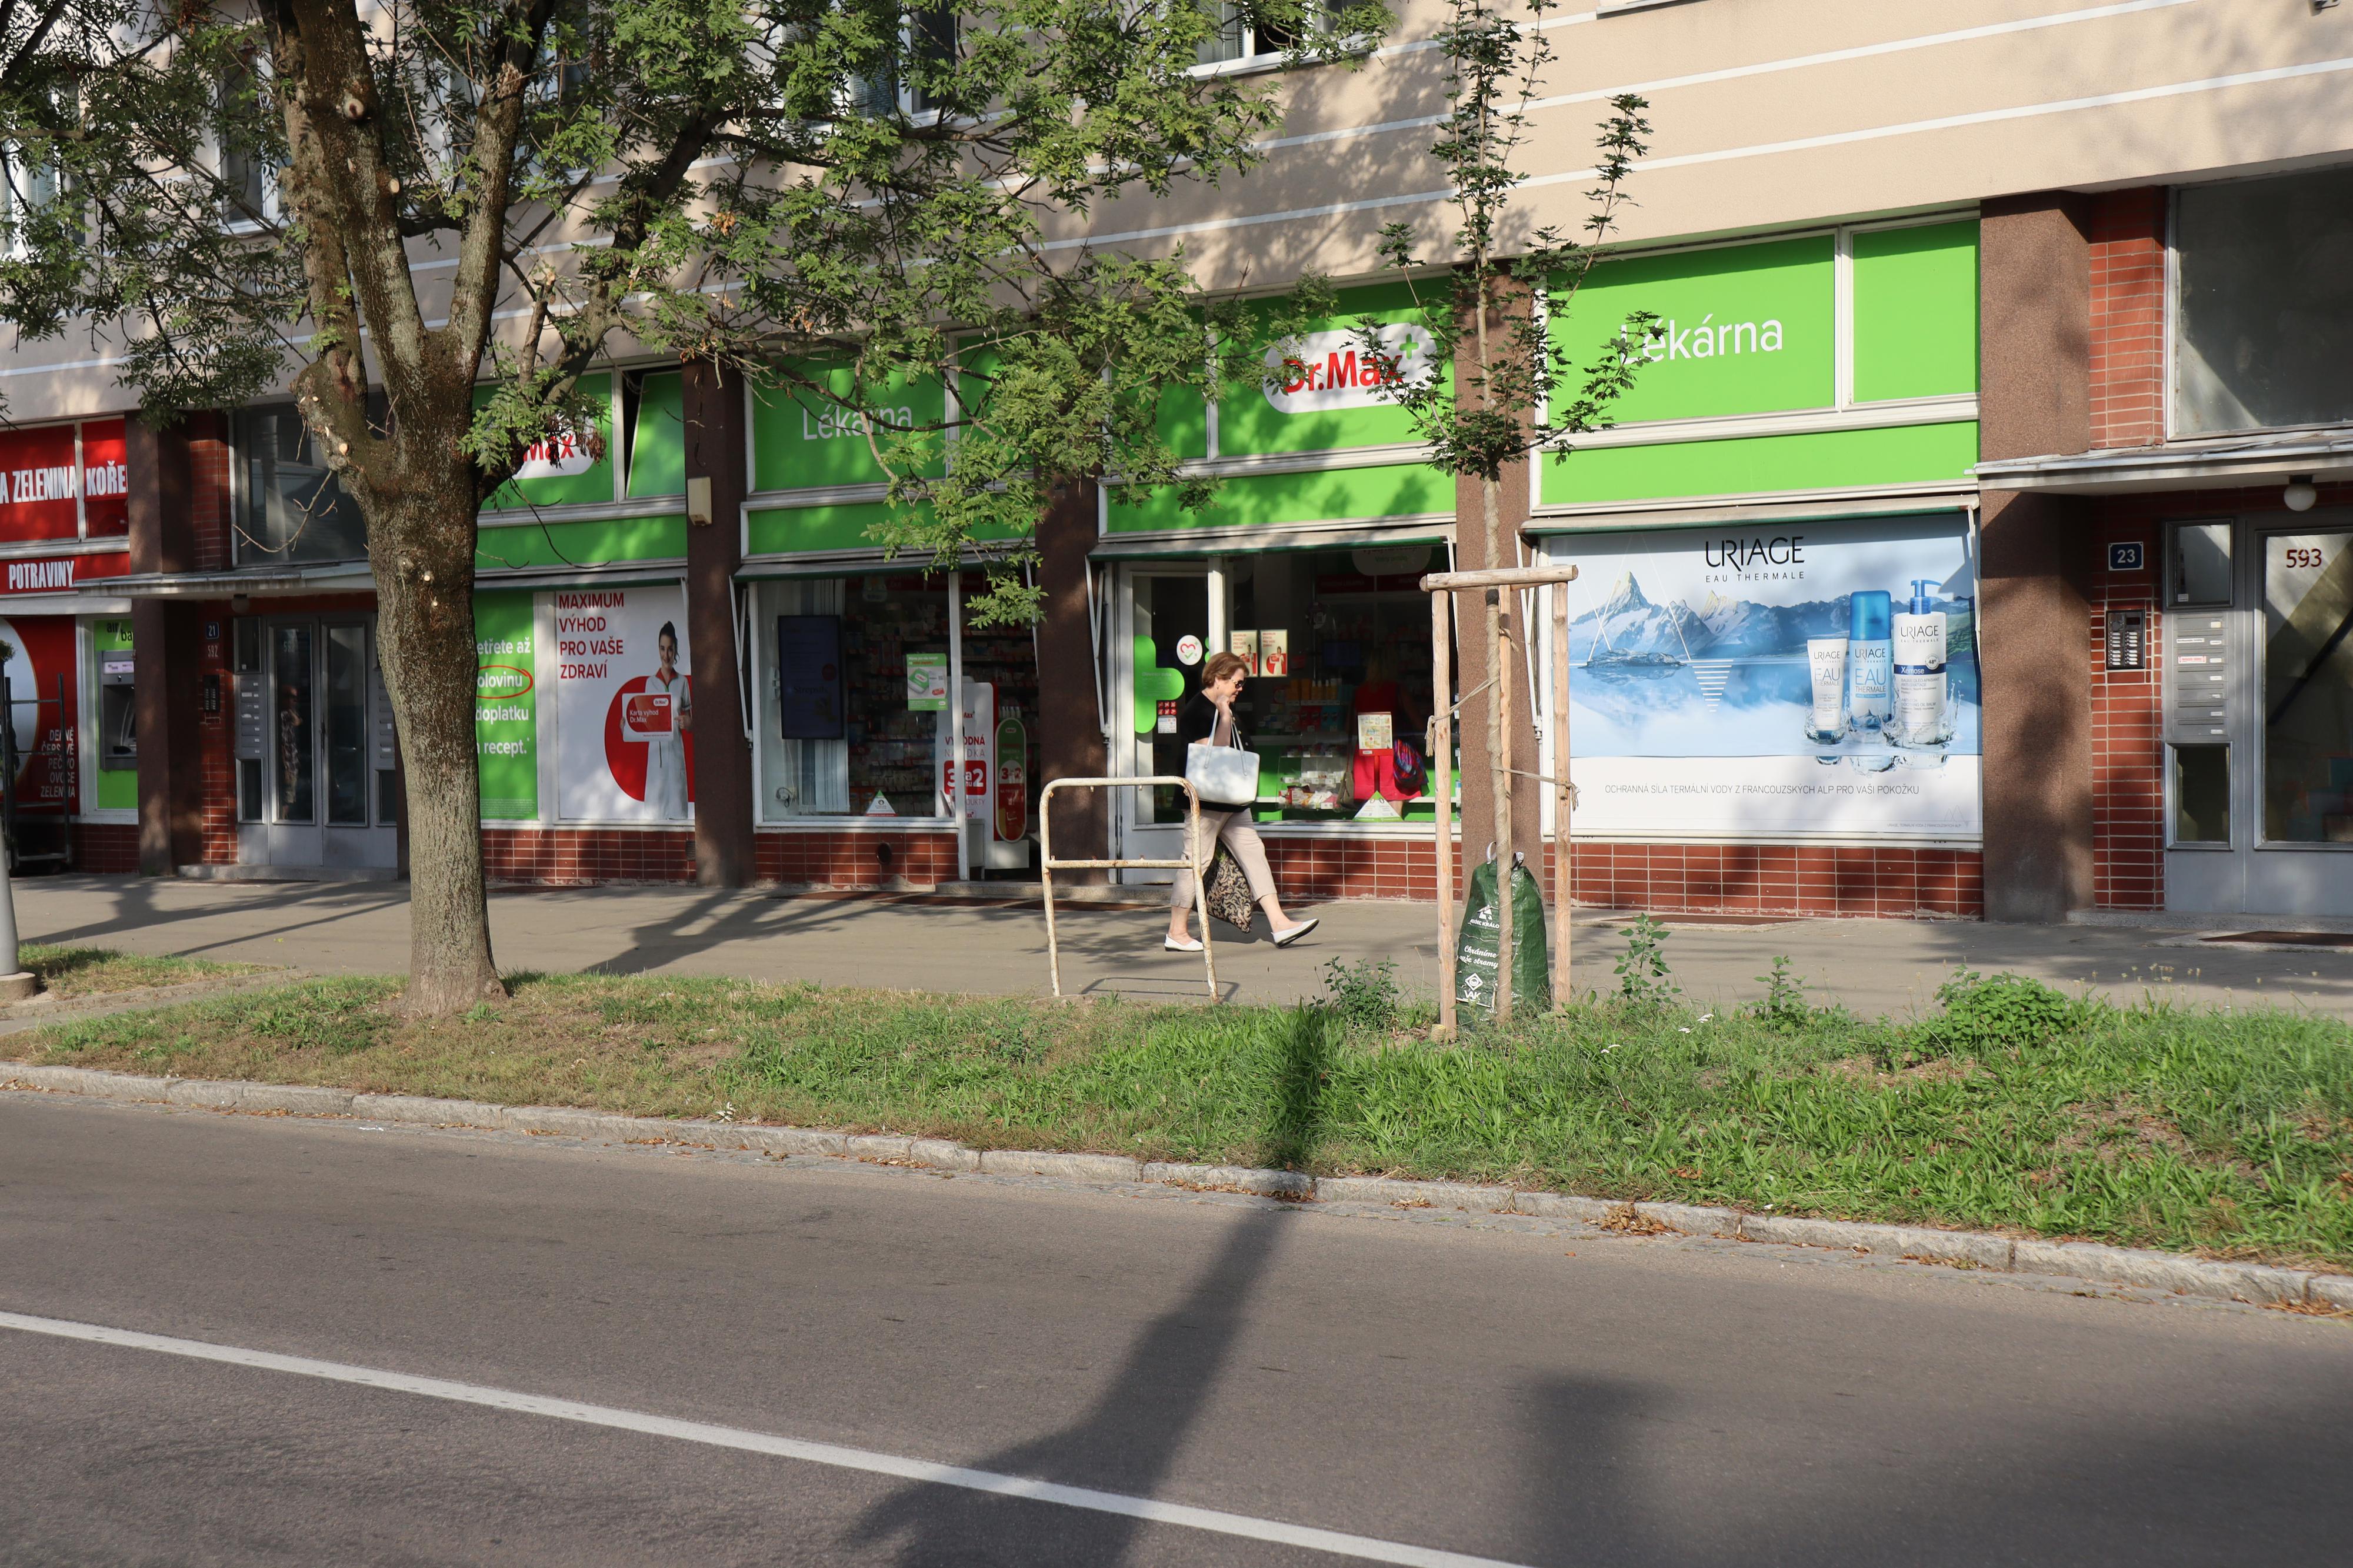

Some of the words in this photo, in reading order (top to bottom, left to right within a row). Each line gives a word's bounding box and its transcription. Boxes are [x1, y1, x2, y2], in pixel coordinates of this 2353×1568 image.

[1621, 313, 1782, 365] Lékárna
[12, 465, 78, 503] ZELENINA
[86, 461, 128, 496] KOŘE
[1705, 536, 1805, 572] URIAGE
[2117, 549, 2135, 563] 23
[2286, 548, 2322, 568] 593
[9, 561, 74, 589] POTRAVINY
[1706, 575, 1728, 583] EAU
[1737, 571, 1805, 582] THERMALE
[559, 592, 624, 609] MAXIMUM
[559, 613, 606, 633] VÝHOD
[208, 625, 216, 637] 21
[1900, 625, 1939, 639] URIAGE
[208, 645, 219, 658] 592
[477, 638, 514, 655] etřete
[516, 636, 531, 654] až
[560, 640, 586, 656] PRO
[589, 635, 624, 655] VAŠE
[1814, 651, 1841, 660] URIAGE
[1855, 648, 1886, 660] URIAGE
[561, 659, 608, 679] ZDRAVÍ
[1815, 668, 1841, 681] EAU
[477, 670, 523, 688] olovinu
[1855, 668, 1887, 686] EAU
[644, 709, 659, 718] výhod
[972, 768, 984, 788] 2
[1605, 783, 1649, 794] OCHRANNÁ
[1651, 783, 1668, 794] SÍLA
[1670, 783, 1708, 794] TERMÁLNÍ
[1710, 783, 1733, 794] VODY
[1735, 783, 1740, 794] Z
[1742, 783, 1815, 794] FRANCOUZSKÝCH
[1817, 783, 1834, 794] ALP
[1837, 783, 1854, 794] PRO
[1856, 783, 1875, 794] VAŠI
[1877, 783, 1919, 794] POKOŽKU
[1464, 945, 1497, 959] Chráníme
[1473, 958, 1499, 969] stromy
[1464, 989, 1481, 1000] VAK
